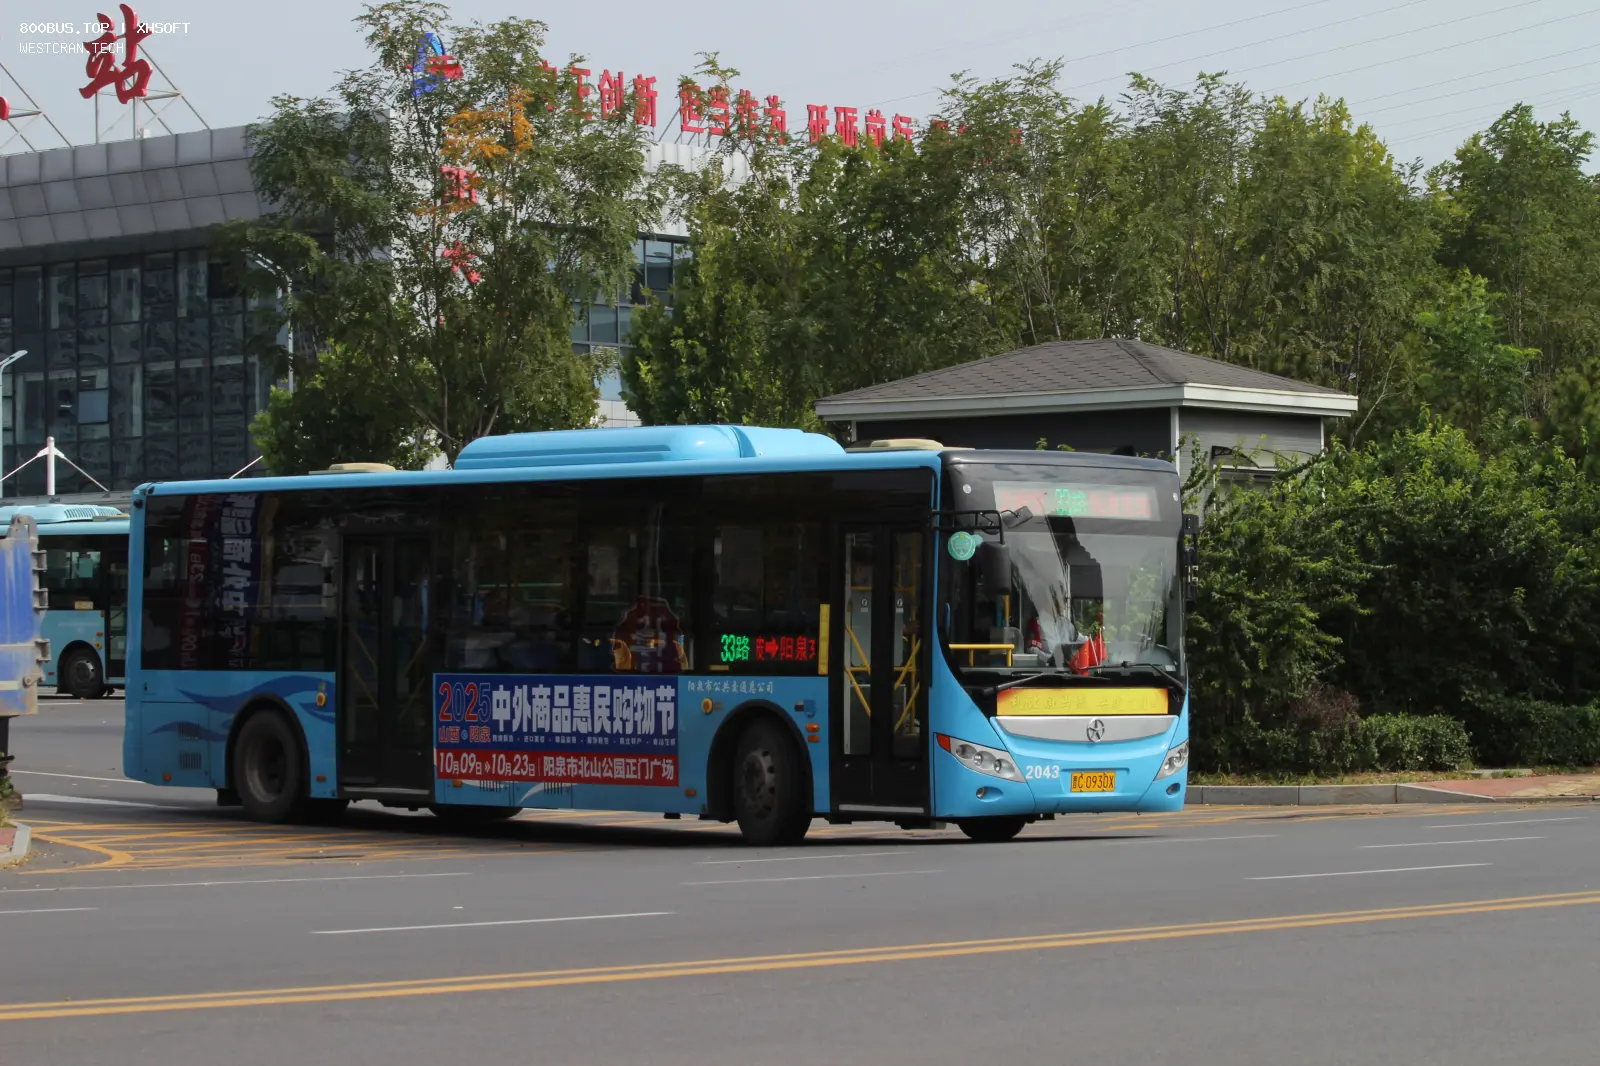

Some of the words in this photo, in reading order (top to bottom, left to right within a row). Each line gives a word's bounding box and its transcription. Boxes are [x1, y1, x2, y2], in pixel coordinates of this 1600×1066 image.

[79, 3, 152, 104] 站
[721, 634, 750, 661] 33路
[439, 682, 491, 722] 2025
[492, 684, 675, 735] 中外商品惠民购物节
[543, 757, 674, 780] 阳泉市北山公园正门广场
[1025, 765, 1060, 779] 2043
